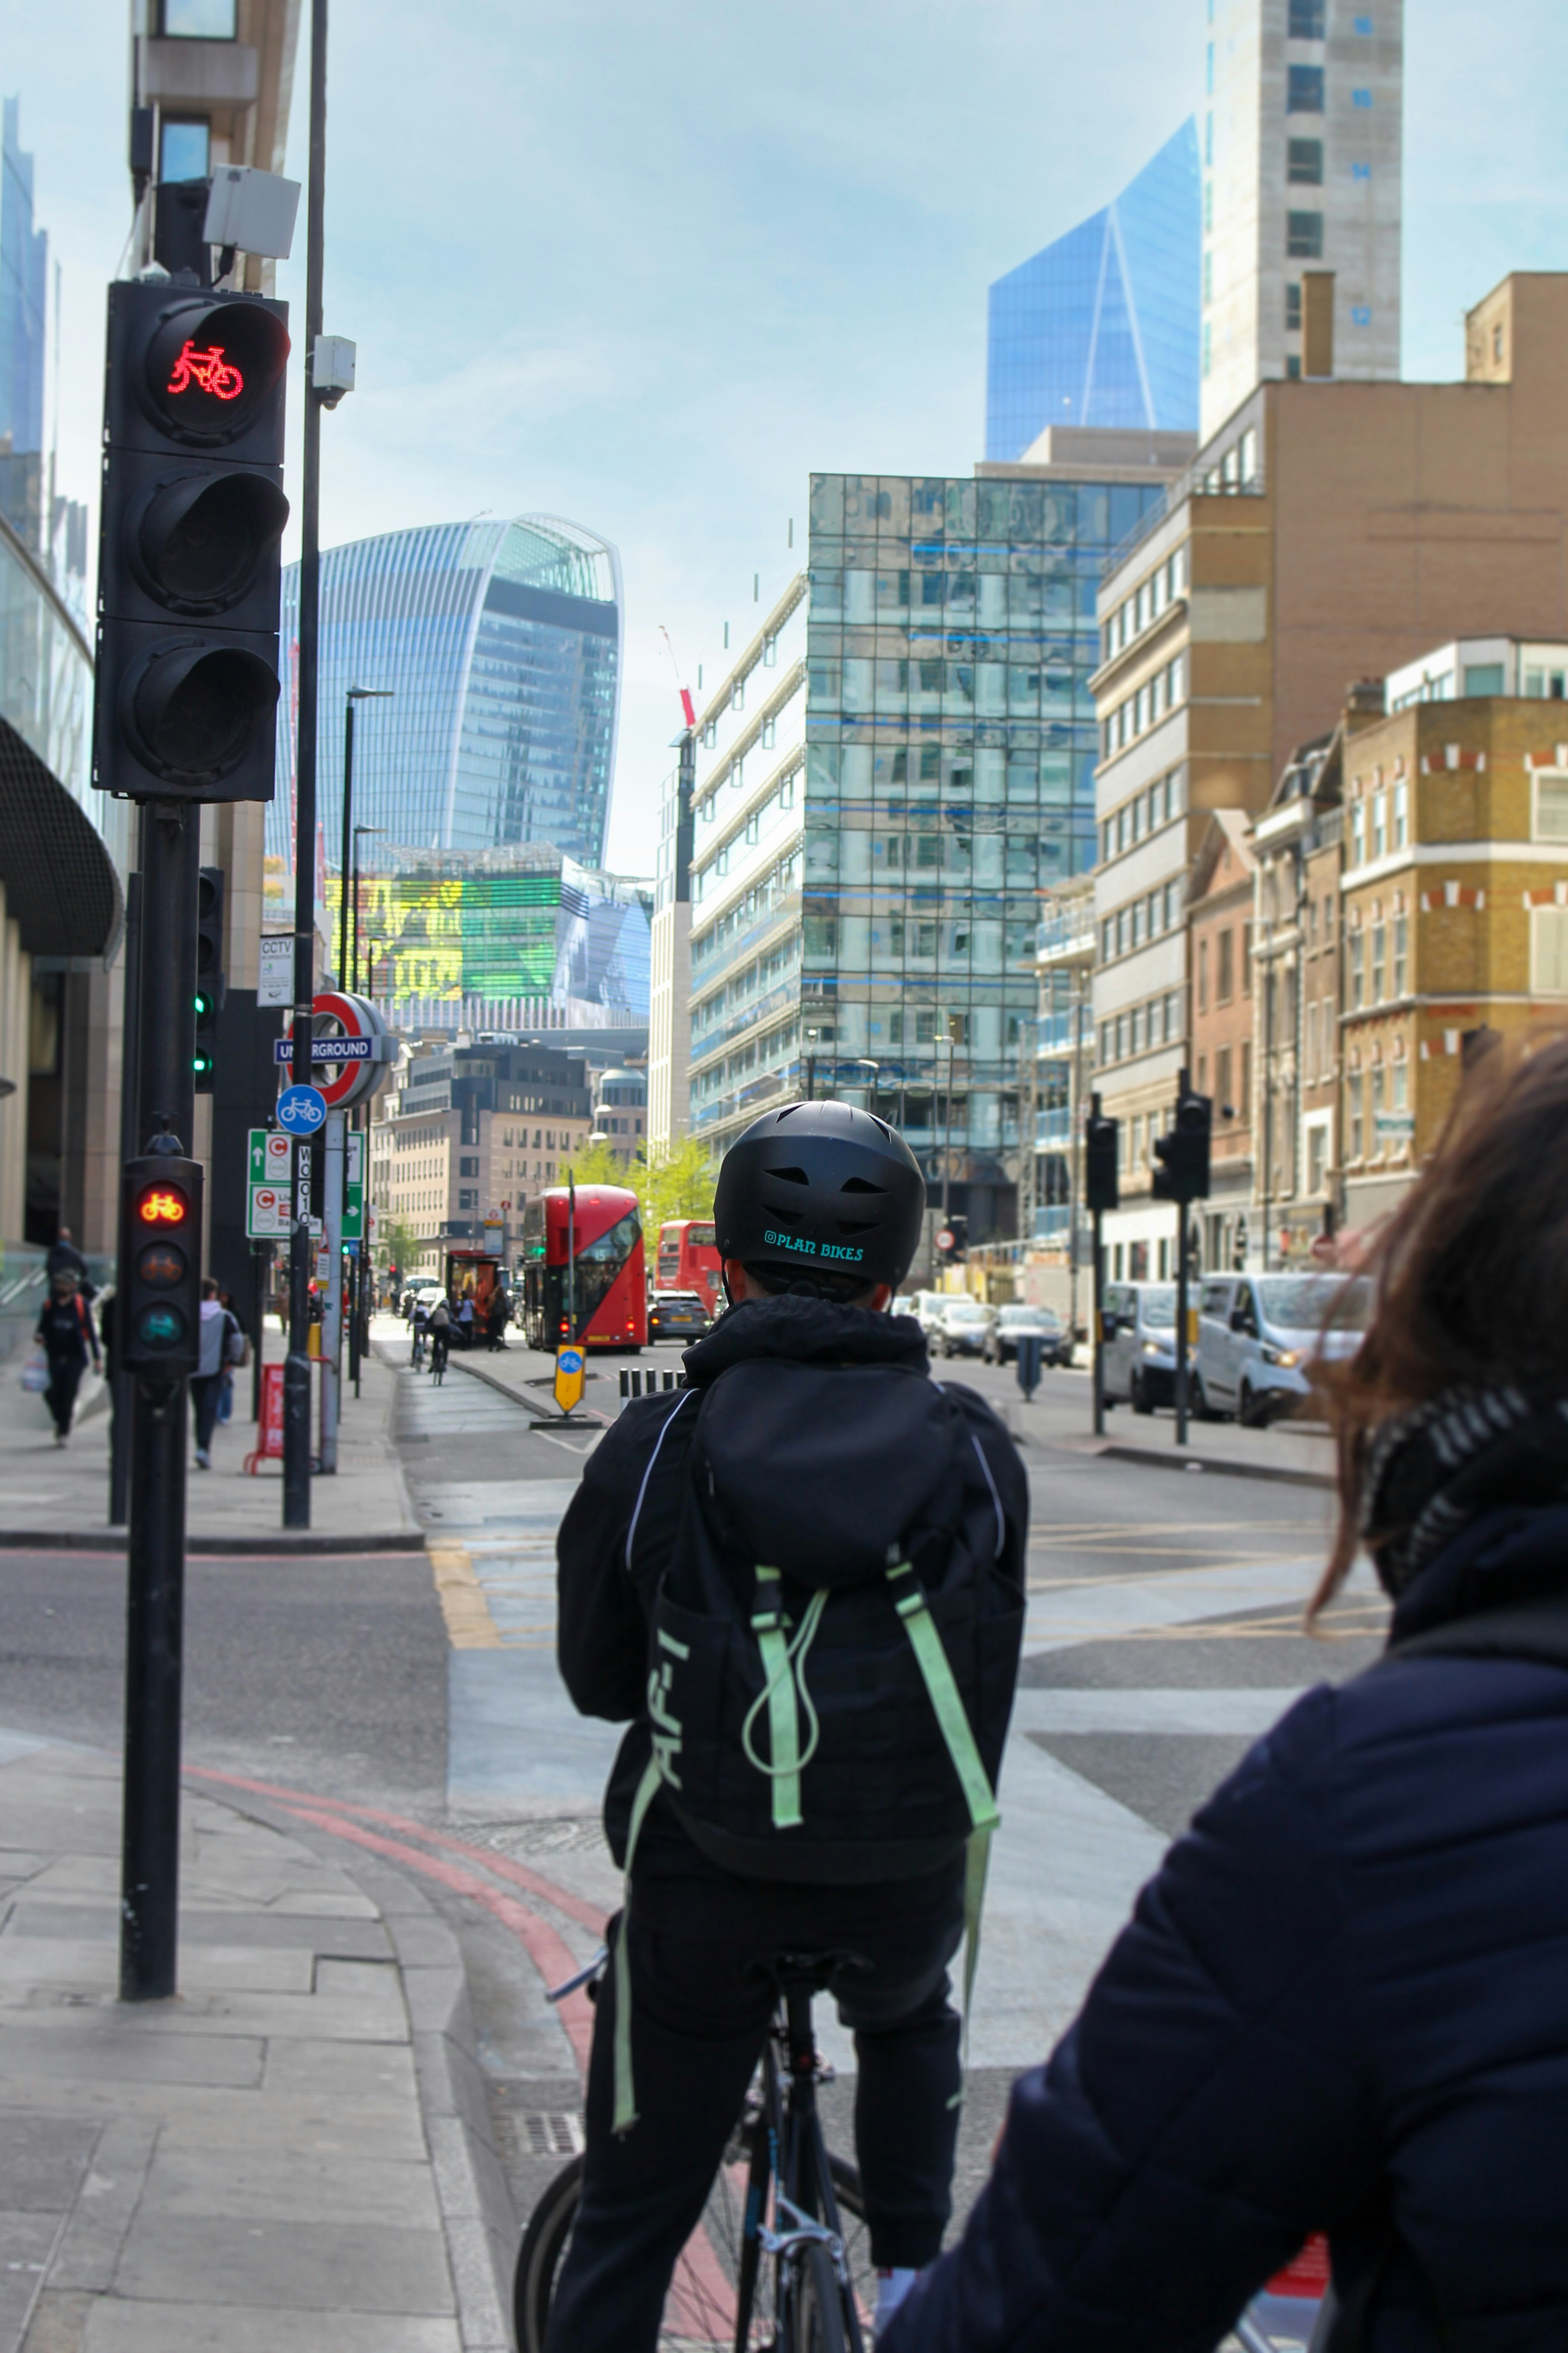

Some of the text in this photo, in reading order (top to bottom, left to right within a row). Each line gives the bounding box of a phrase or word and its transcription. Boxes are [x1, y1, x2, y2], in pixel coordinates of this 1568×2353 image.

[262, 941, 291, 954] CCTV
[280, 1042, 368, 1058] UNRGROUND
[777, 1234, 864, 1261] PLAN BIKES
